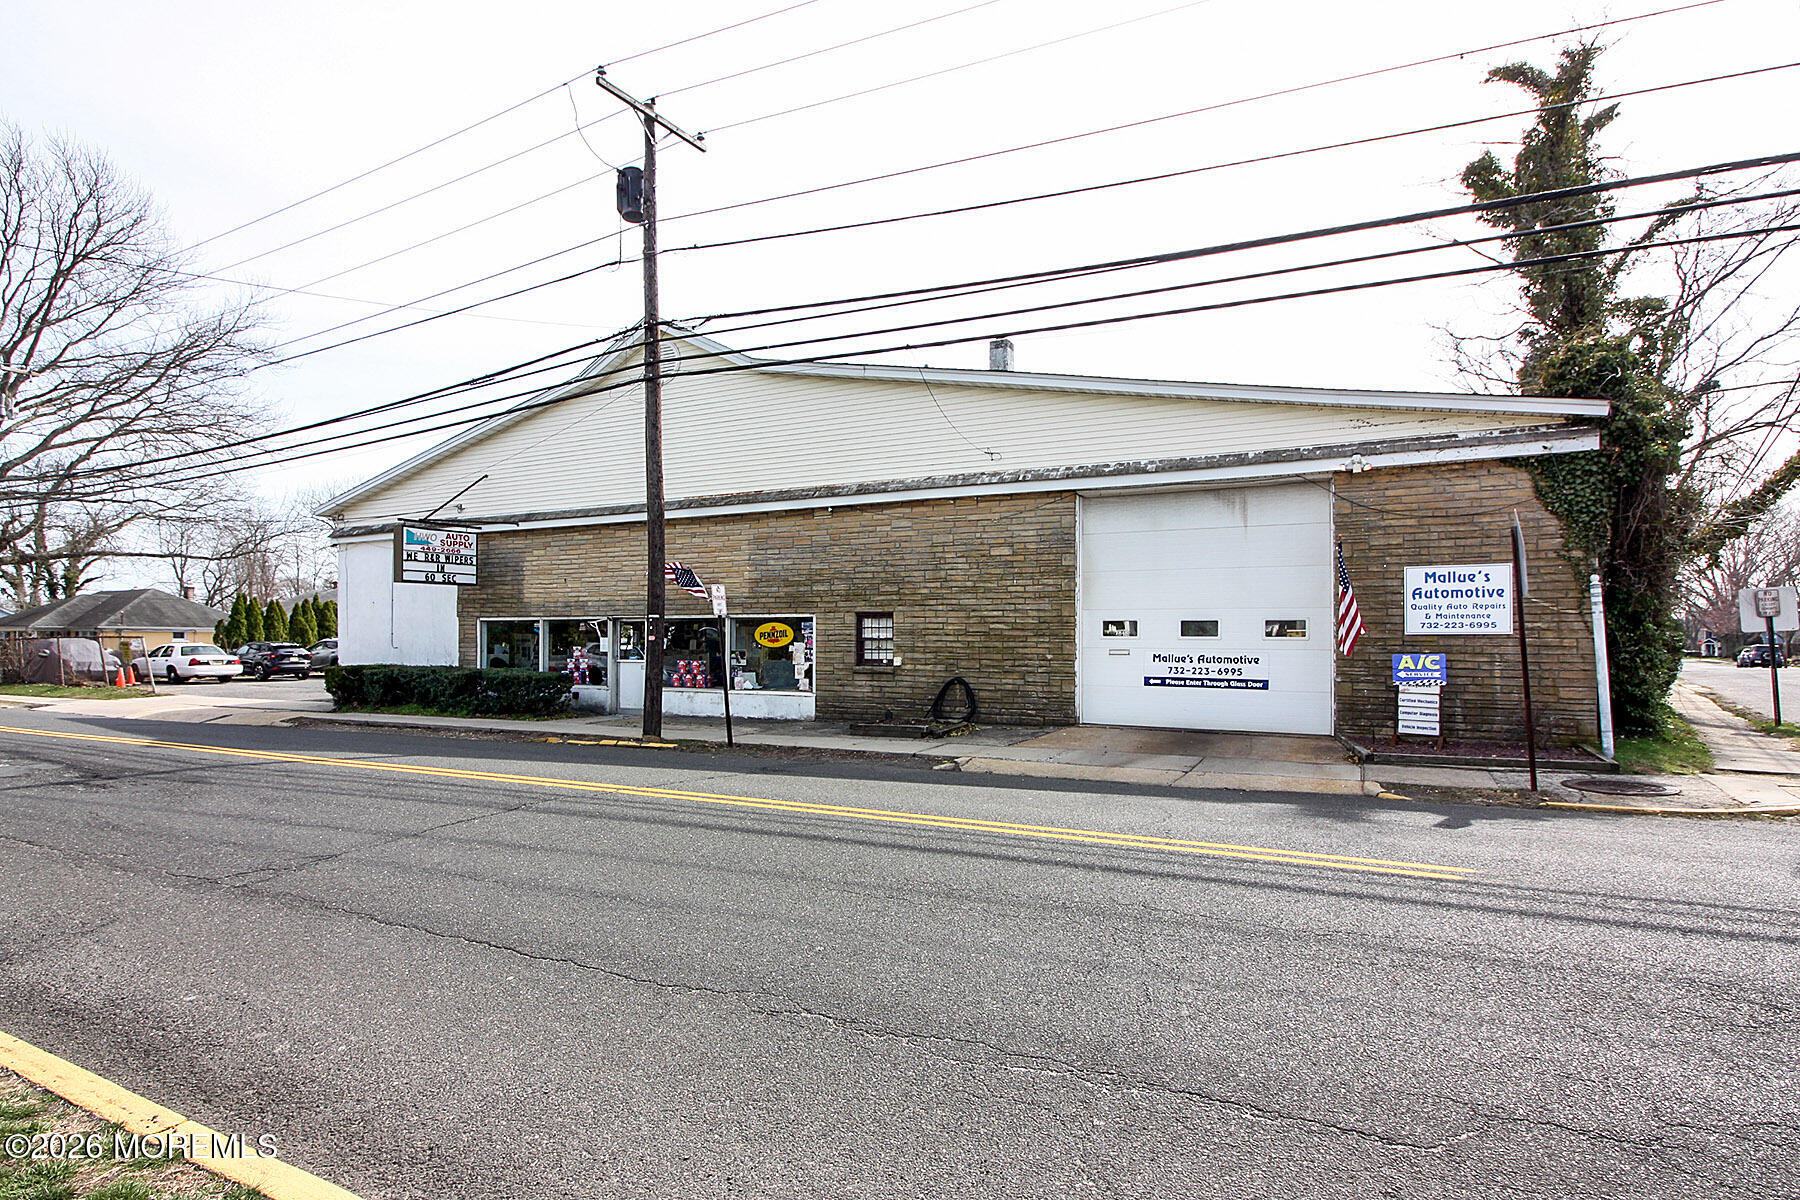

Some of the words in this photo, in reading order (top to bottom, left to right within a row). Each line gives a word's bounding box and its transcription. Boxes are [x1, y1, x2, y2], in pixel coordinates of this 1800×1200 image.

[446, 533, 470, 542] AUTO
[440, 539, 473, 548] SUPPLY
[406, 552, 418, 561] WE
[445, 554, 474, 565] WIPERS
[436, 563, 446, 573] IN
[425, 573, 436, 581] 60
[441, 574, 457, 583] SEC
[1424, 570, 1491, 584] Mallue's
[1411, 586, 1505, 601] Automotive
[1410, 603, 1443, 611] Quality
[1420, 621, 1498, 629] 732-223-6995
[759, 629, 789, 641] PENNZOIL
[1152, 653, 1194, 663] Mallue's
[1197, 654, 1260, 665] Automotive
[1397, 655, 1441, 670] A/C
[1167, 666, 1244, 676] 732-223-6995
[1203, 680, 1229, 688] Through
